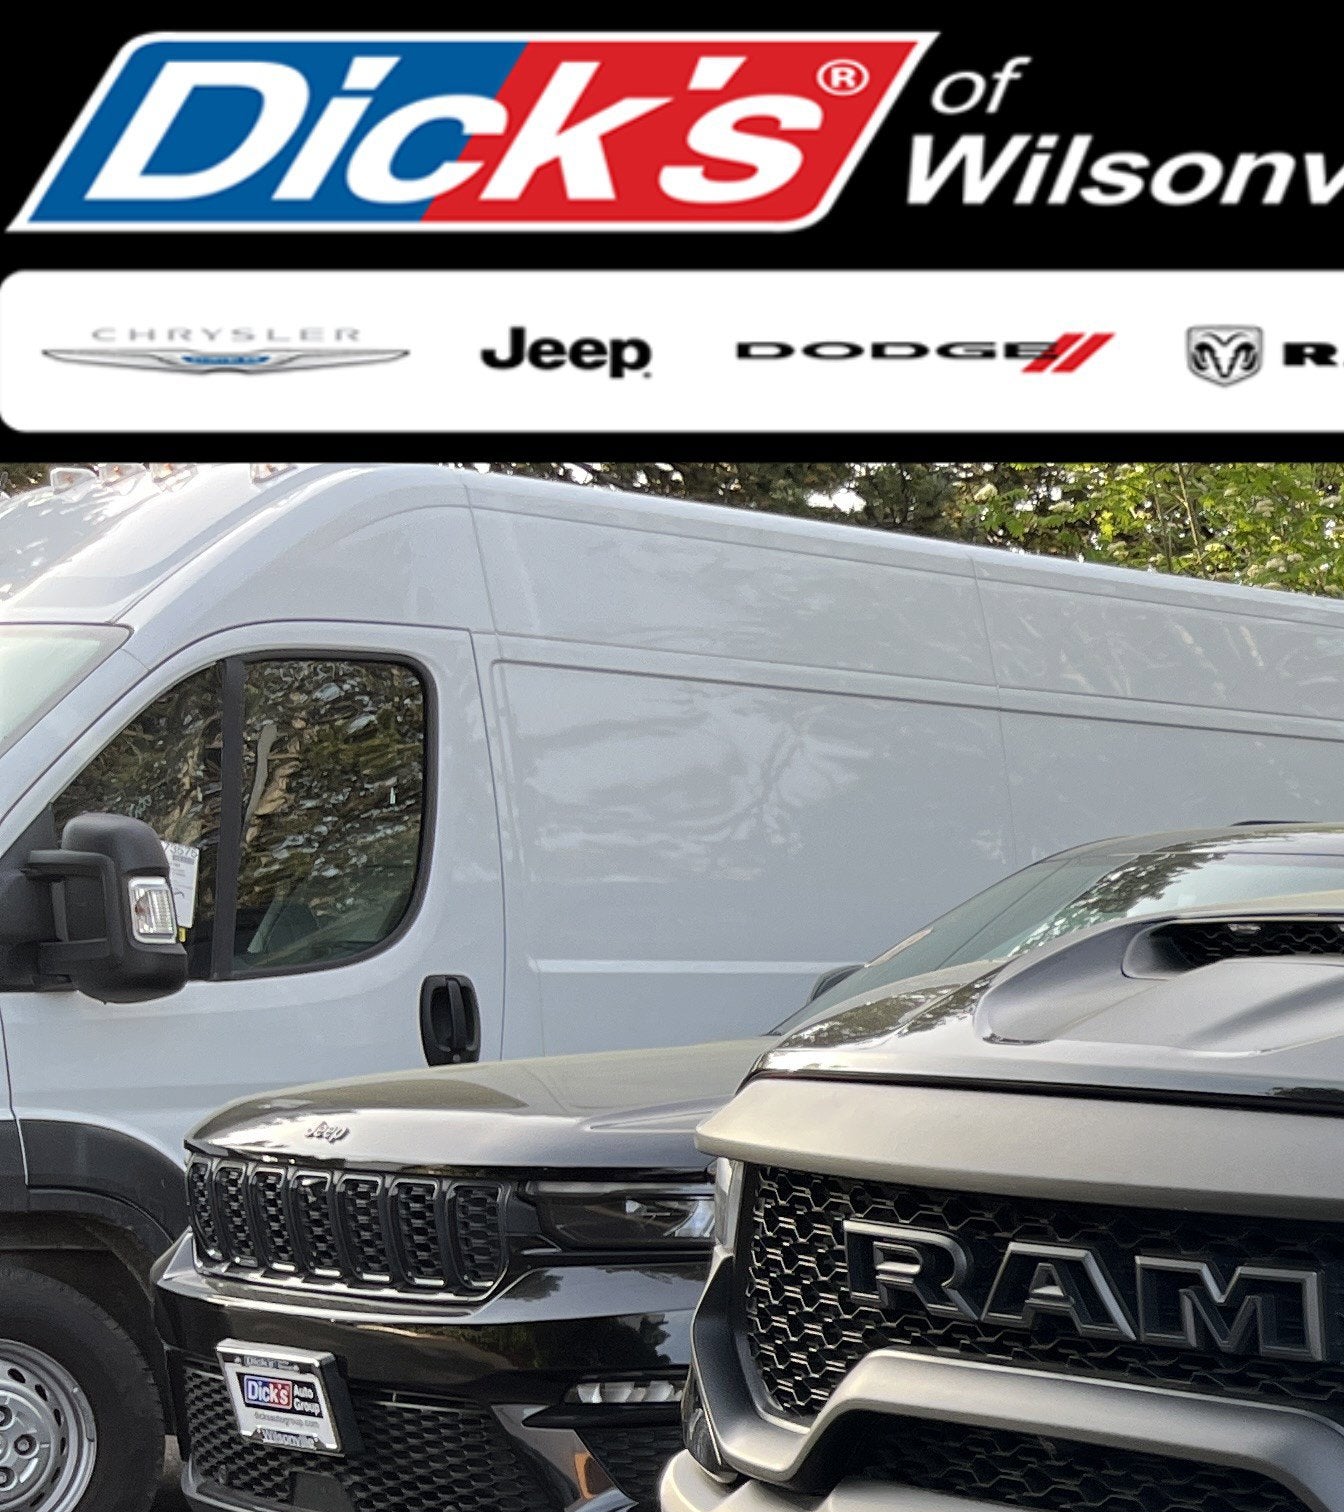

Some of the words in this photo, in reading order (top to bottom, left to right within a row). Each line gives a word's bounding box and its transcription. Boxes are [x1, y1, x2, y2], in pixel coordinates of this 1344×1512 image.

[304, 1121, 350, 1144] Jeep
[843, 1219, 1325, 1362] RAM
[247, 1380, 289, 1405] Dick's
